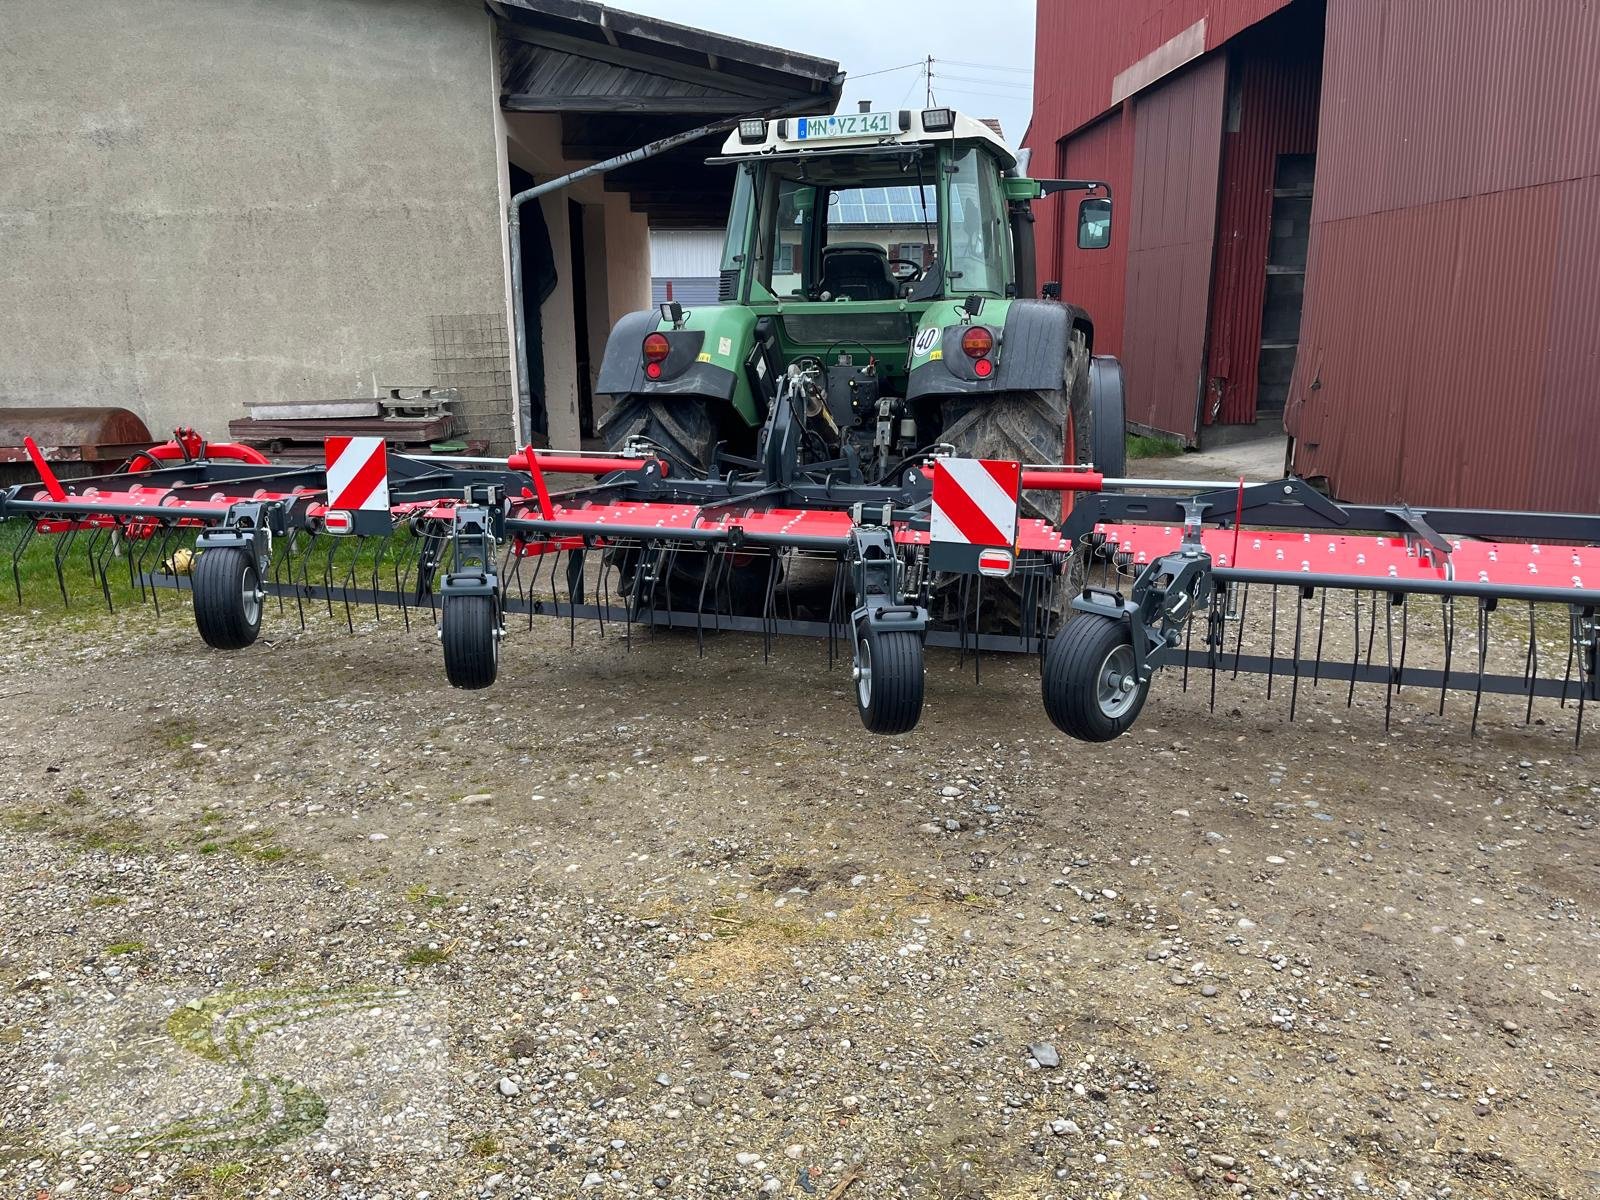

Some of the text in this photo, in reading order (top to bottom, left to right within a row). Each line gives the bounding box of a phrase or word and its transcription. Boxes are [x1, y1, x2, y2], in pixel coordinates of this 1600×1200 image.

[807, 119, 827, 136] MN
[838, 118, 857, 134] YZ
[860, 115, 889, 132] 141
[916, 329, 936, 350] 40
